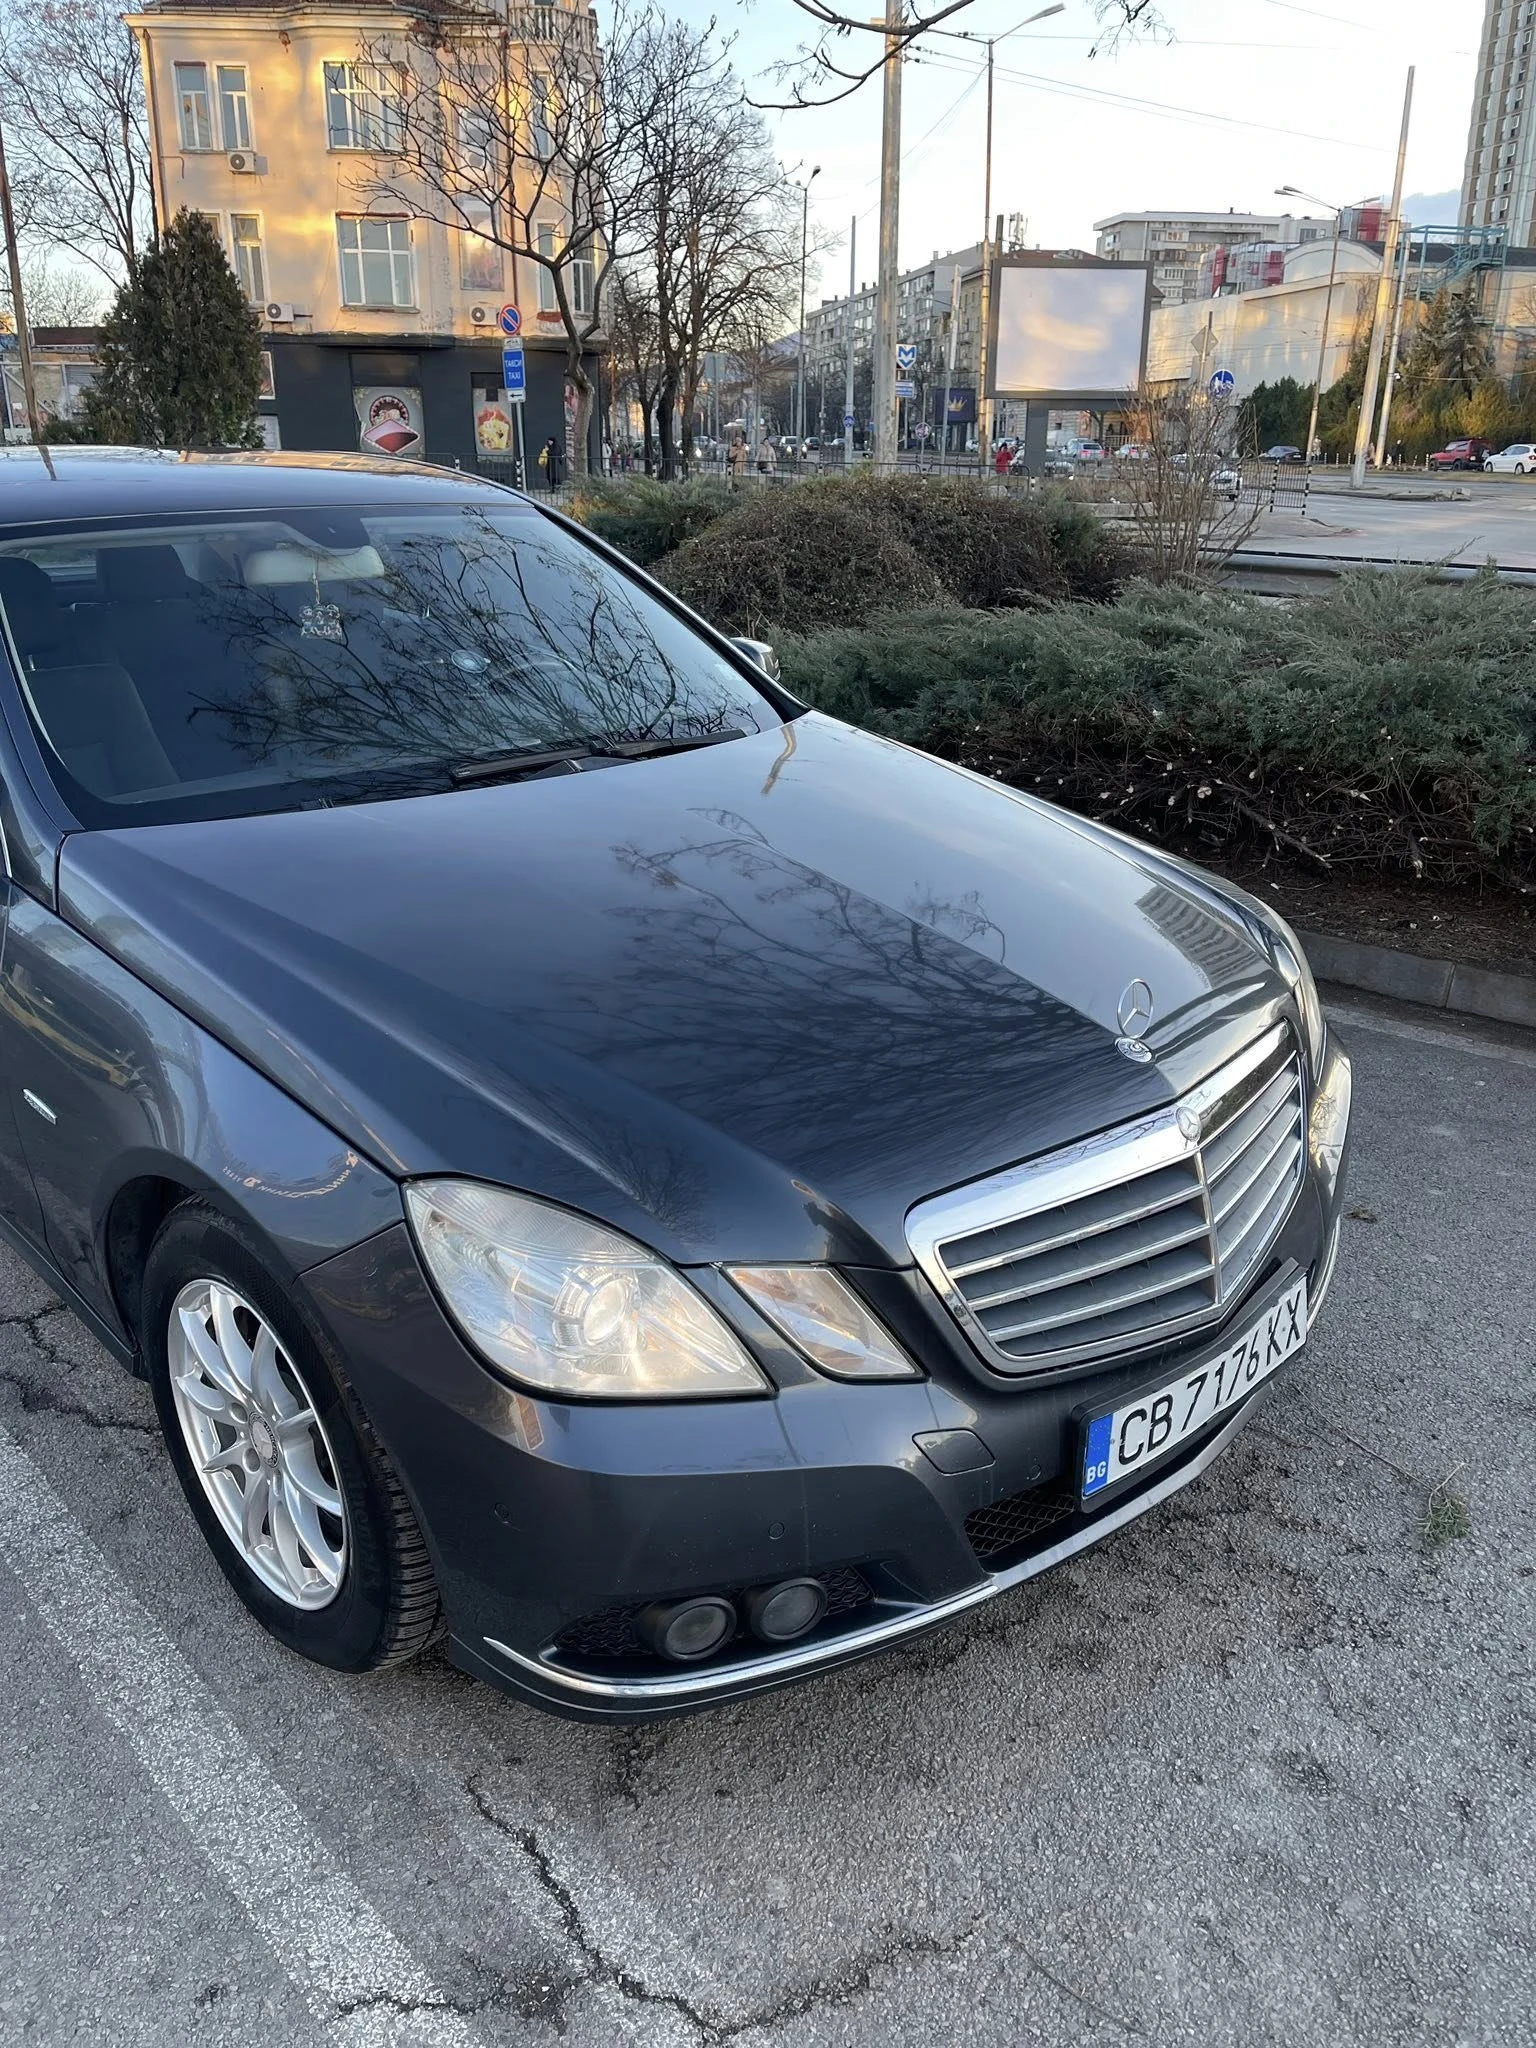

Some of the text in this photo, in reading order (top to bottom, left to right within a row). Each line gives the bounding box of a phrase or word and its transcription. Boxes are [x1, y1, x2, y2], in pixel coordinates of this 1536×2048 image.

[507, 371, 521, 380] TAXI
[1118, 1289, 1301, 1465] CB 7176 KX
[1086, 1461, 1107, 1484] BG
